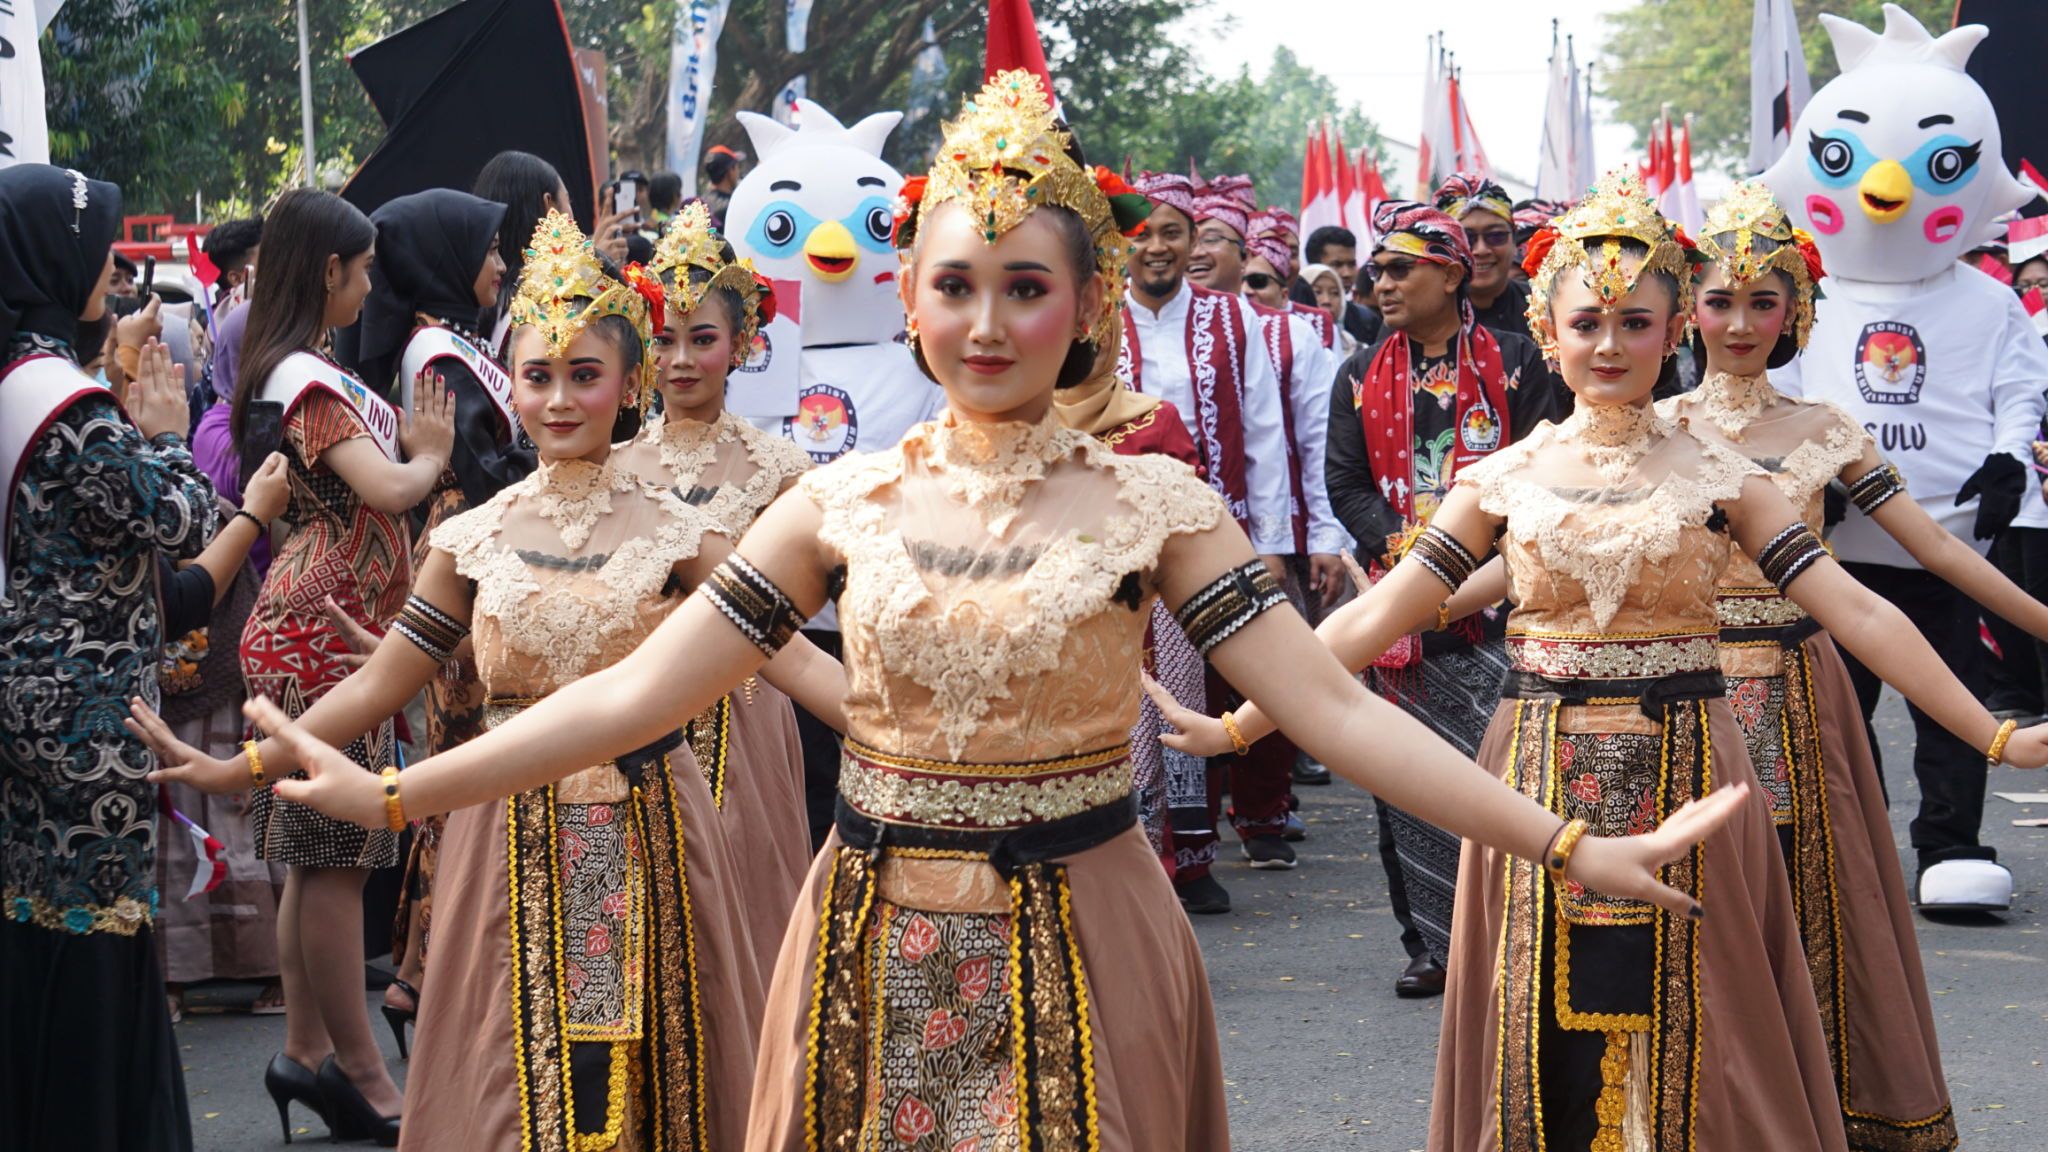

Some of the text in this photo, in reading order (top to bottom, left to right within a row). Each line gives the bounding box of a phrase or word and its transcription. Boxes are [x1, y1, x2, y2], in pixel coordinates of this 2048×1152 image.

[1867, 323, 1913, 336] KOMISI
[478, 360, 504, 393] INU
[1855, 363, 1905, 402] PEMILIHAN
[368, 399, 394, 441] INU
